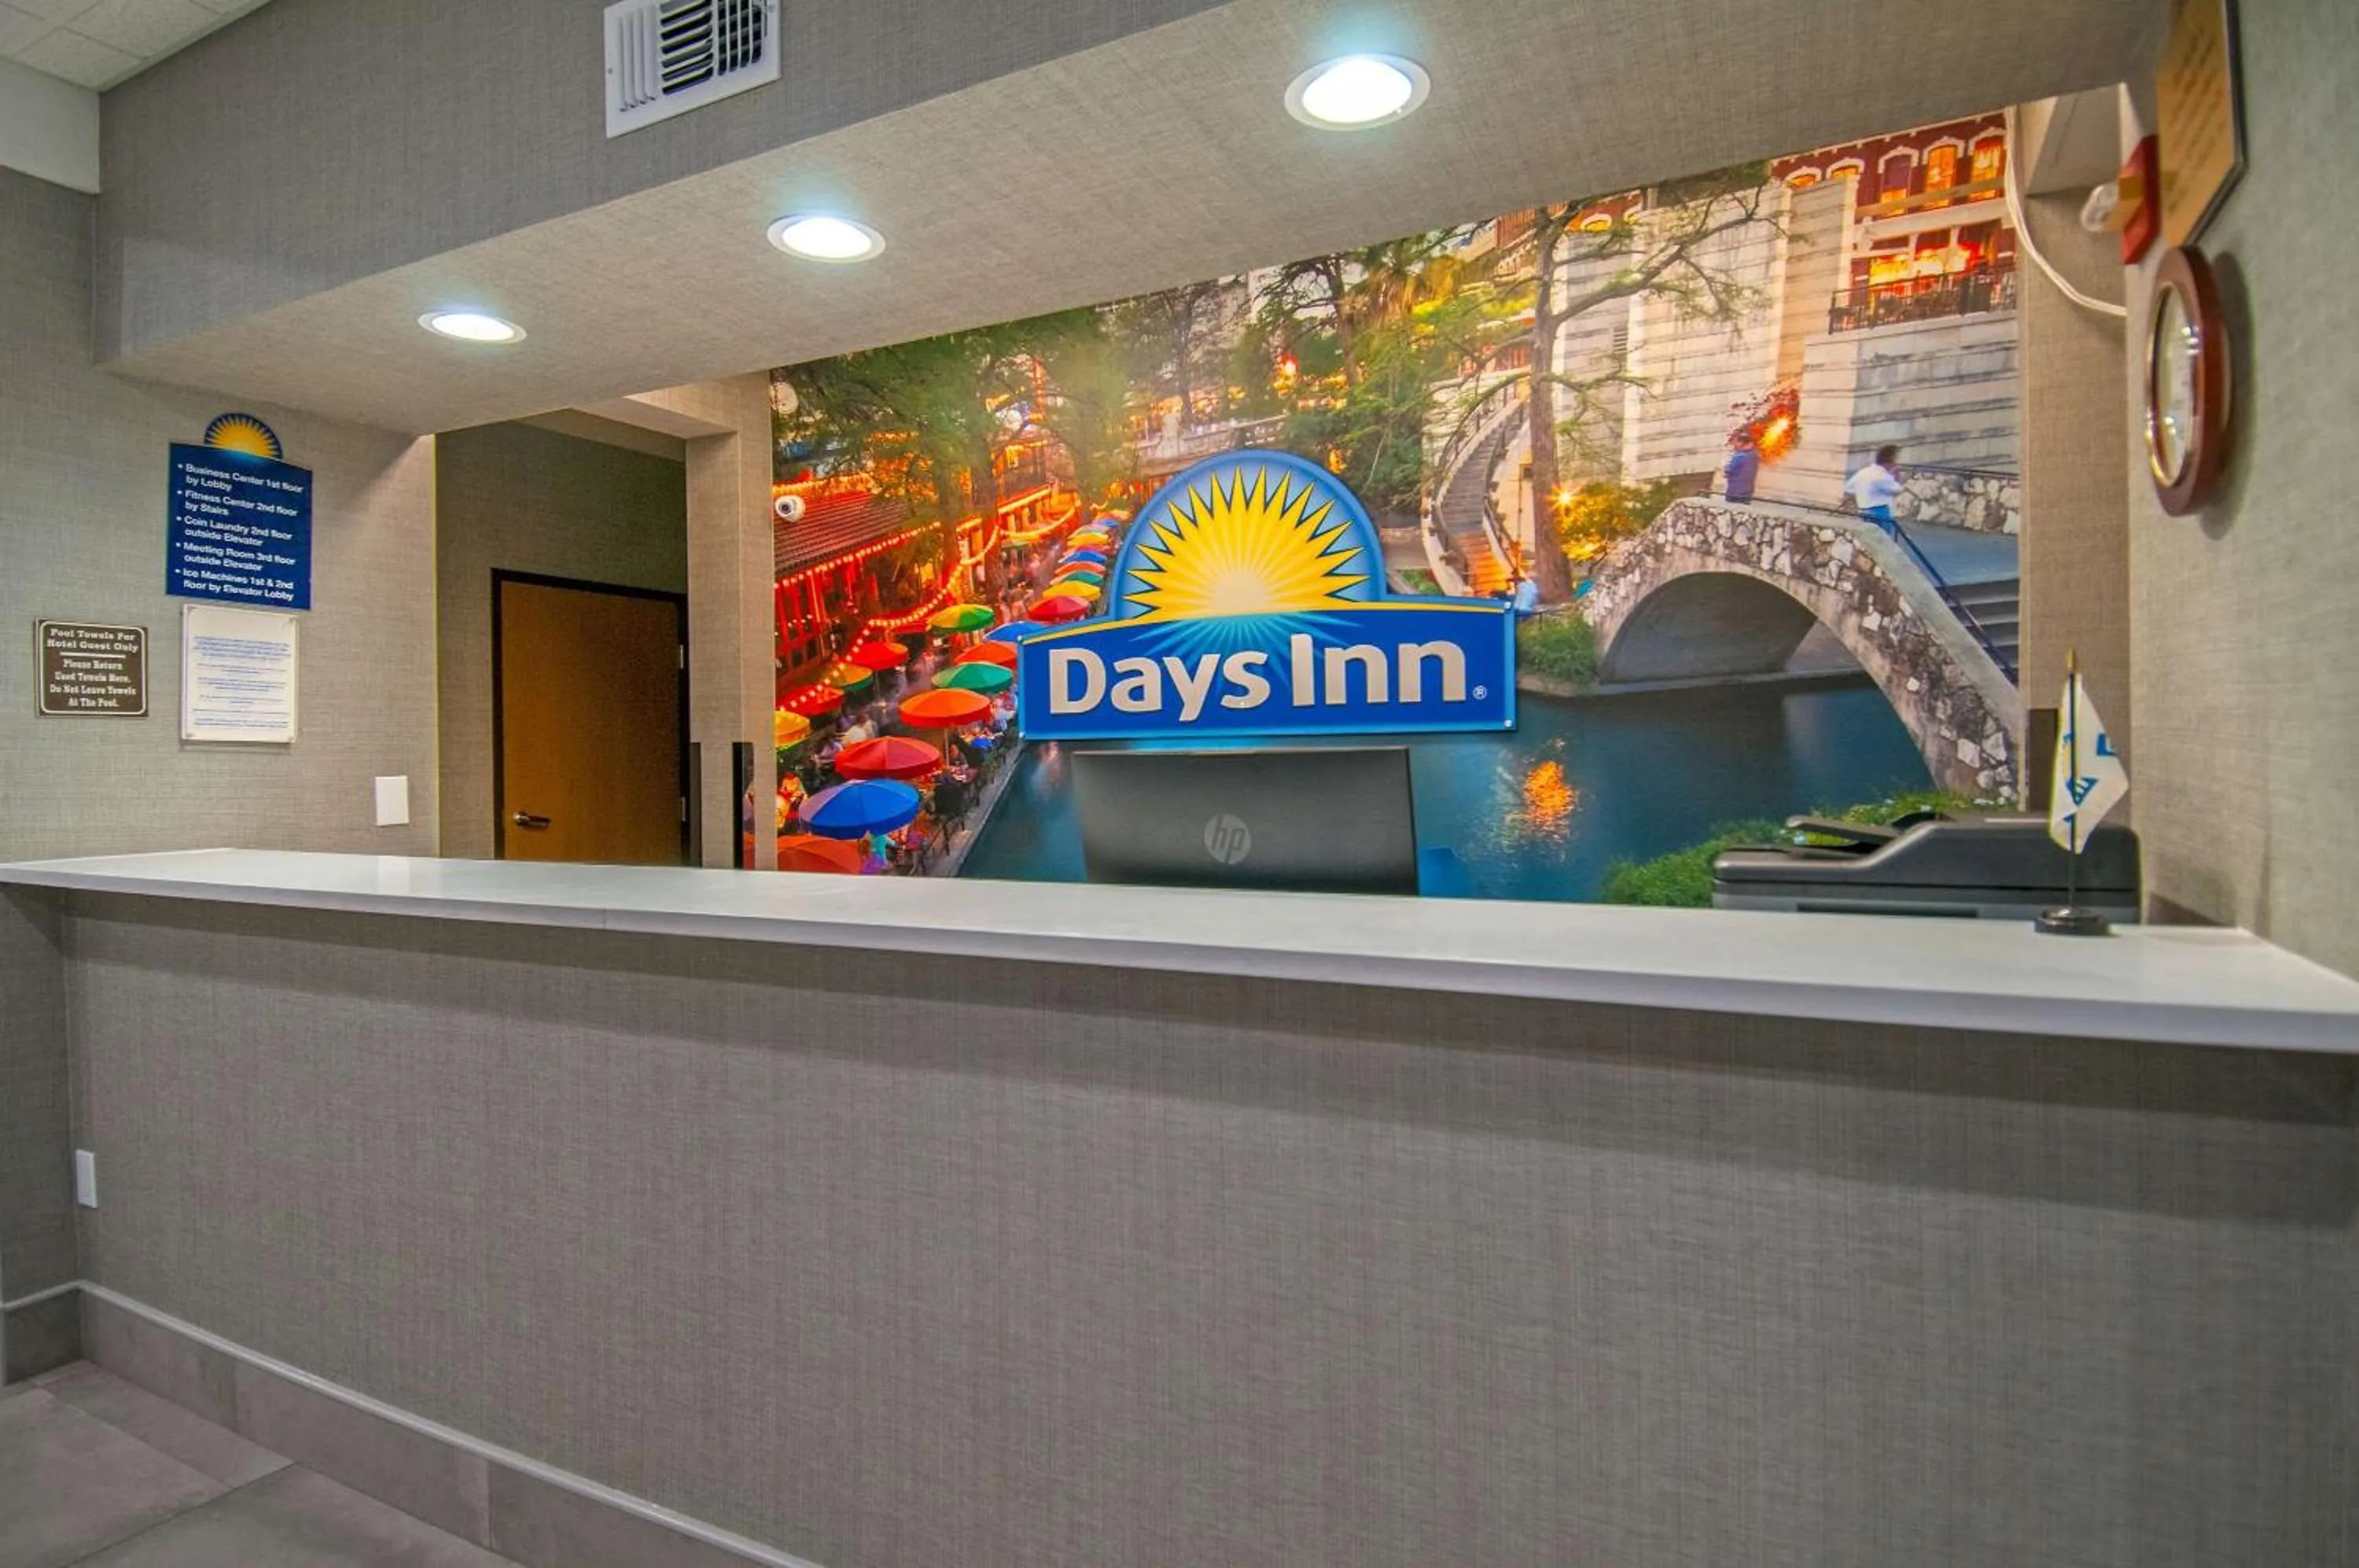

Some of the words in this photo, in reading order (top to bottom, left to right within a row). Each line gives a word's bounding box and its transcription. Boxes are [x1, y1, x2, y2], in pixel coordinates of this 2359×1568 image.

[186, 464, 230, 480] Business
[233, 473, 264, 485] Center
[267, 480, 281, 489] 1st
[282, 482, 304, 494] floor
[186, 475, 197, 486] by
[201, 478, 233, 491] Lobby
[185, 490, 221, 503] Fitness
[223, 497, 255, 509] Center
[256, 502, 275, 513] 2nd
[276, 506, 299, 517] floor
[185, 502, 197, 512] by
[201, 503, 230, 516] Stairs
[184, 516, 208, 527] Coin
[210, 520, 249, 535] Laundry
[251, 526, 269, 536] 2nd
[270, 529, 293, 540] floor
[185, 528, 222, 540] outside
[224, 532, 263, 547] Elevator
[183, 542, 224, 557] Meeting
[226, 548, 255, 559] Room
[256, 553, 272, 562] 3rd
[274, 555, 296, 566] floor
[184, 555, 221, 565] outside
[223, 558, 263, 571] Elevator
[182, 569, 199, 578] Ice
[201, 571, 248, 584] Machines
[250, 577, 265, 586] 1st
[266, 578, 274, 587] &
[275, 580, 294, 590] 2nd
[183, 580, 206, 590] floor
[208, 583, 221, 594] by
[223, 585, 263, 596] Elevator
[265, 590, 294, 601] Lobby
[77, 630, 114, 639] Towels
[47, 639, 77, 649] Hotel
[79, 642, 111, 650] Guest
[114, 643, 138, 653] Only
[1048, 647, 1272, 722] Days
[1290, 633, 1467, 707] Inn
[50, 683, 61, 693] Do
[107, 686, 137, 695] Towels
[1210, 814, 1248, 863] hp
